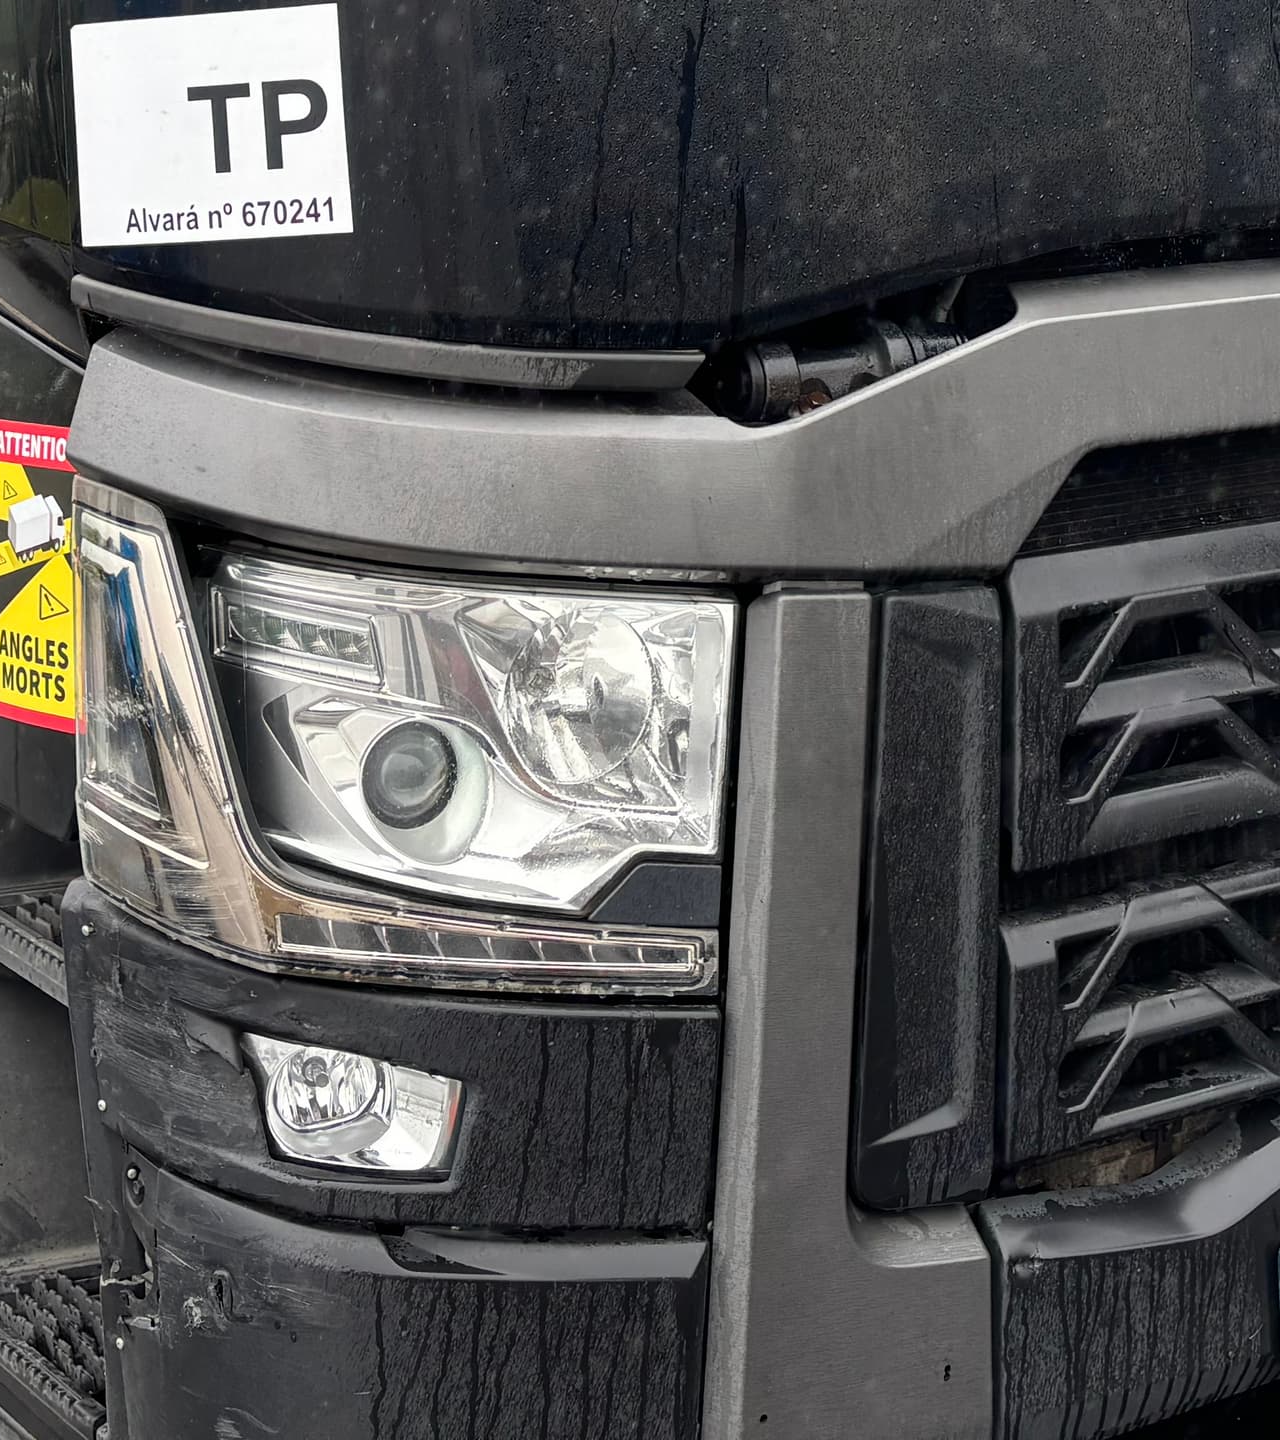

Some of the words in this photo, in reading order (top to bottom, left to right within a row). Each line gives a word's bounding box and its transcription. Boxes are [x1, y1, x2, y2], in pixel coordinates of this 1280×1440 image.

[187, 78, 328, 174] TP
[126, 204, 199, 233] Alvará
[241, 196, 334, 228] 670241
[2, 662, 66, 703] MORTS
